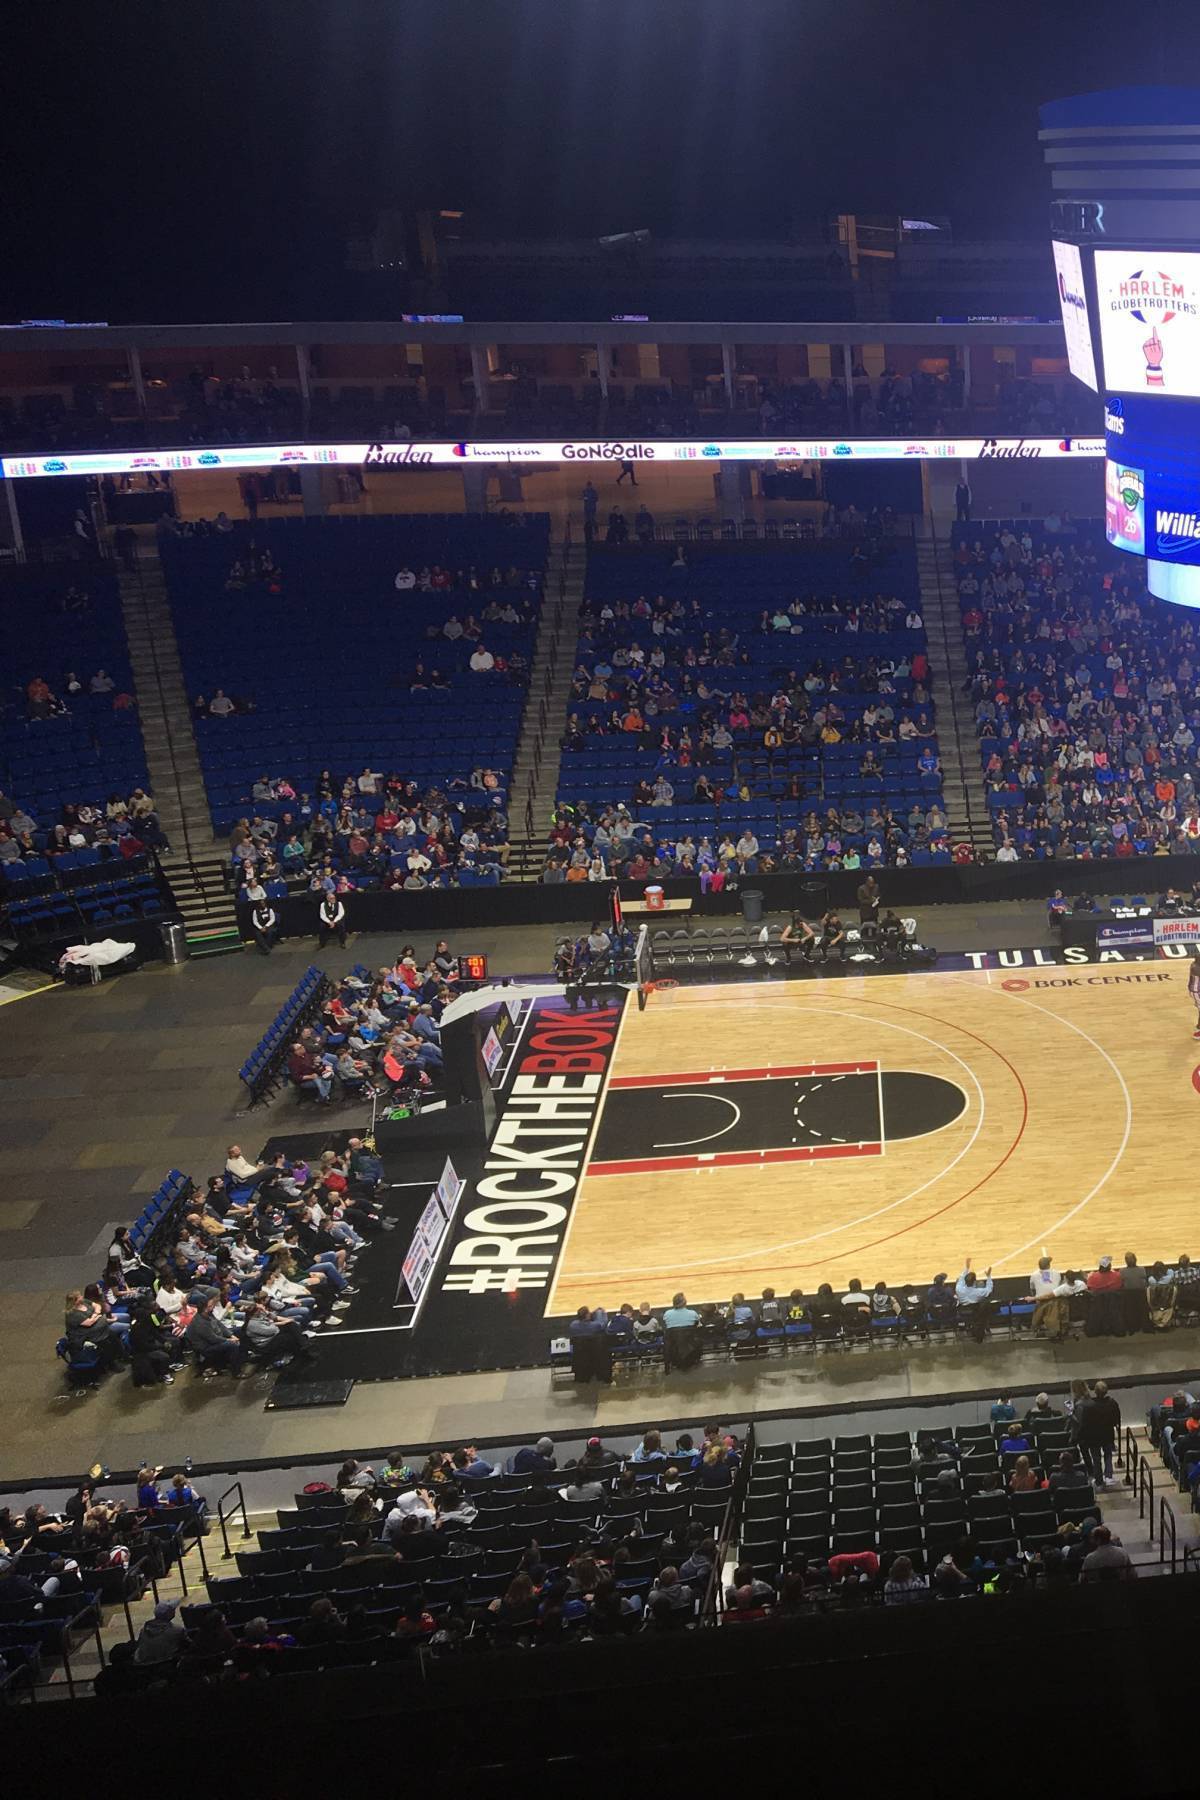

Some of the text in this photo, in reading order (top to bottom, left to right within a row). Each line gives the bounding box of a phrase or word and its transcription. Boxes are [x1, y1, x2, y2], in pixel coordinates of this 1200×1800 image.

[1119, 280, 1185, 299] HARLEM
[1111, 297, 1197, 315] GLOBETROTTERS
[364, 443, 433, 464] Baden
[452, 442, 541, 463] Champion
[977, 440, 1041, 458] Baden
[1162, 923, 1199, 934] HARLEM
[964, 947, 1144, 969] TULSA,
[1034, 973, 1173, 988] BOK CENTER
